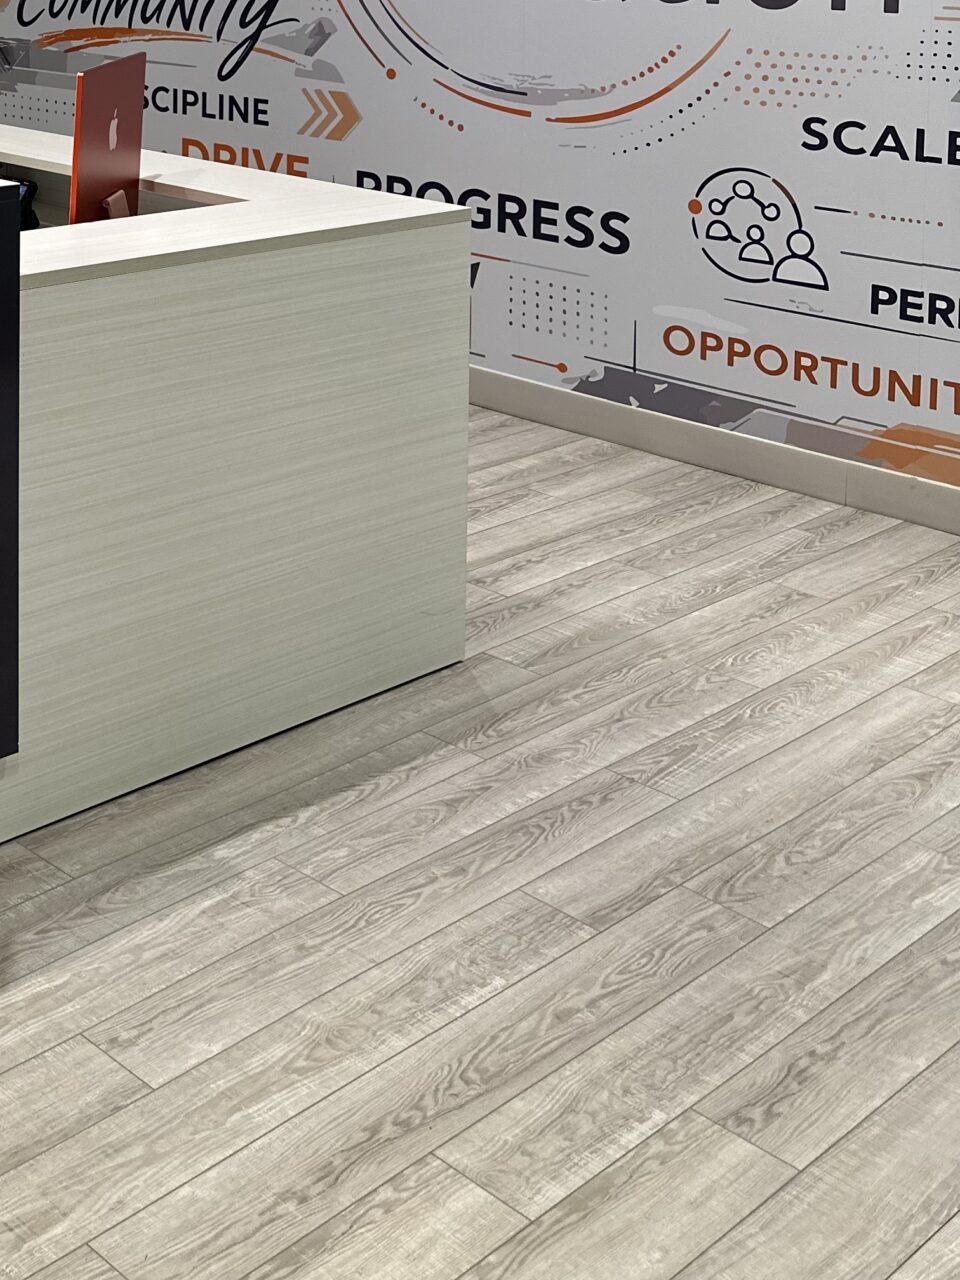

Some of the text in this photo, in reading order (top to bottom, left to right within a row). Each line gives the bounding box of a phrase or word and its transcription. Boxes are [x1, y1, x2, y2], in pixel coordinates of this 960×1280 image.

[801, 117, 960, 166] SCALE
[871, 283, 960, 329] PER
[662, 325, 960, 416] OPPORTUNIT
